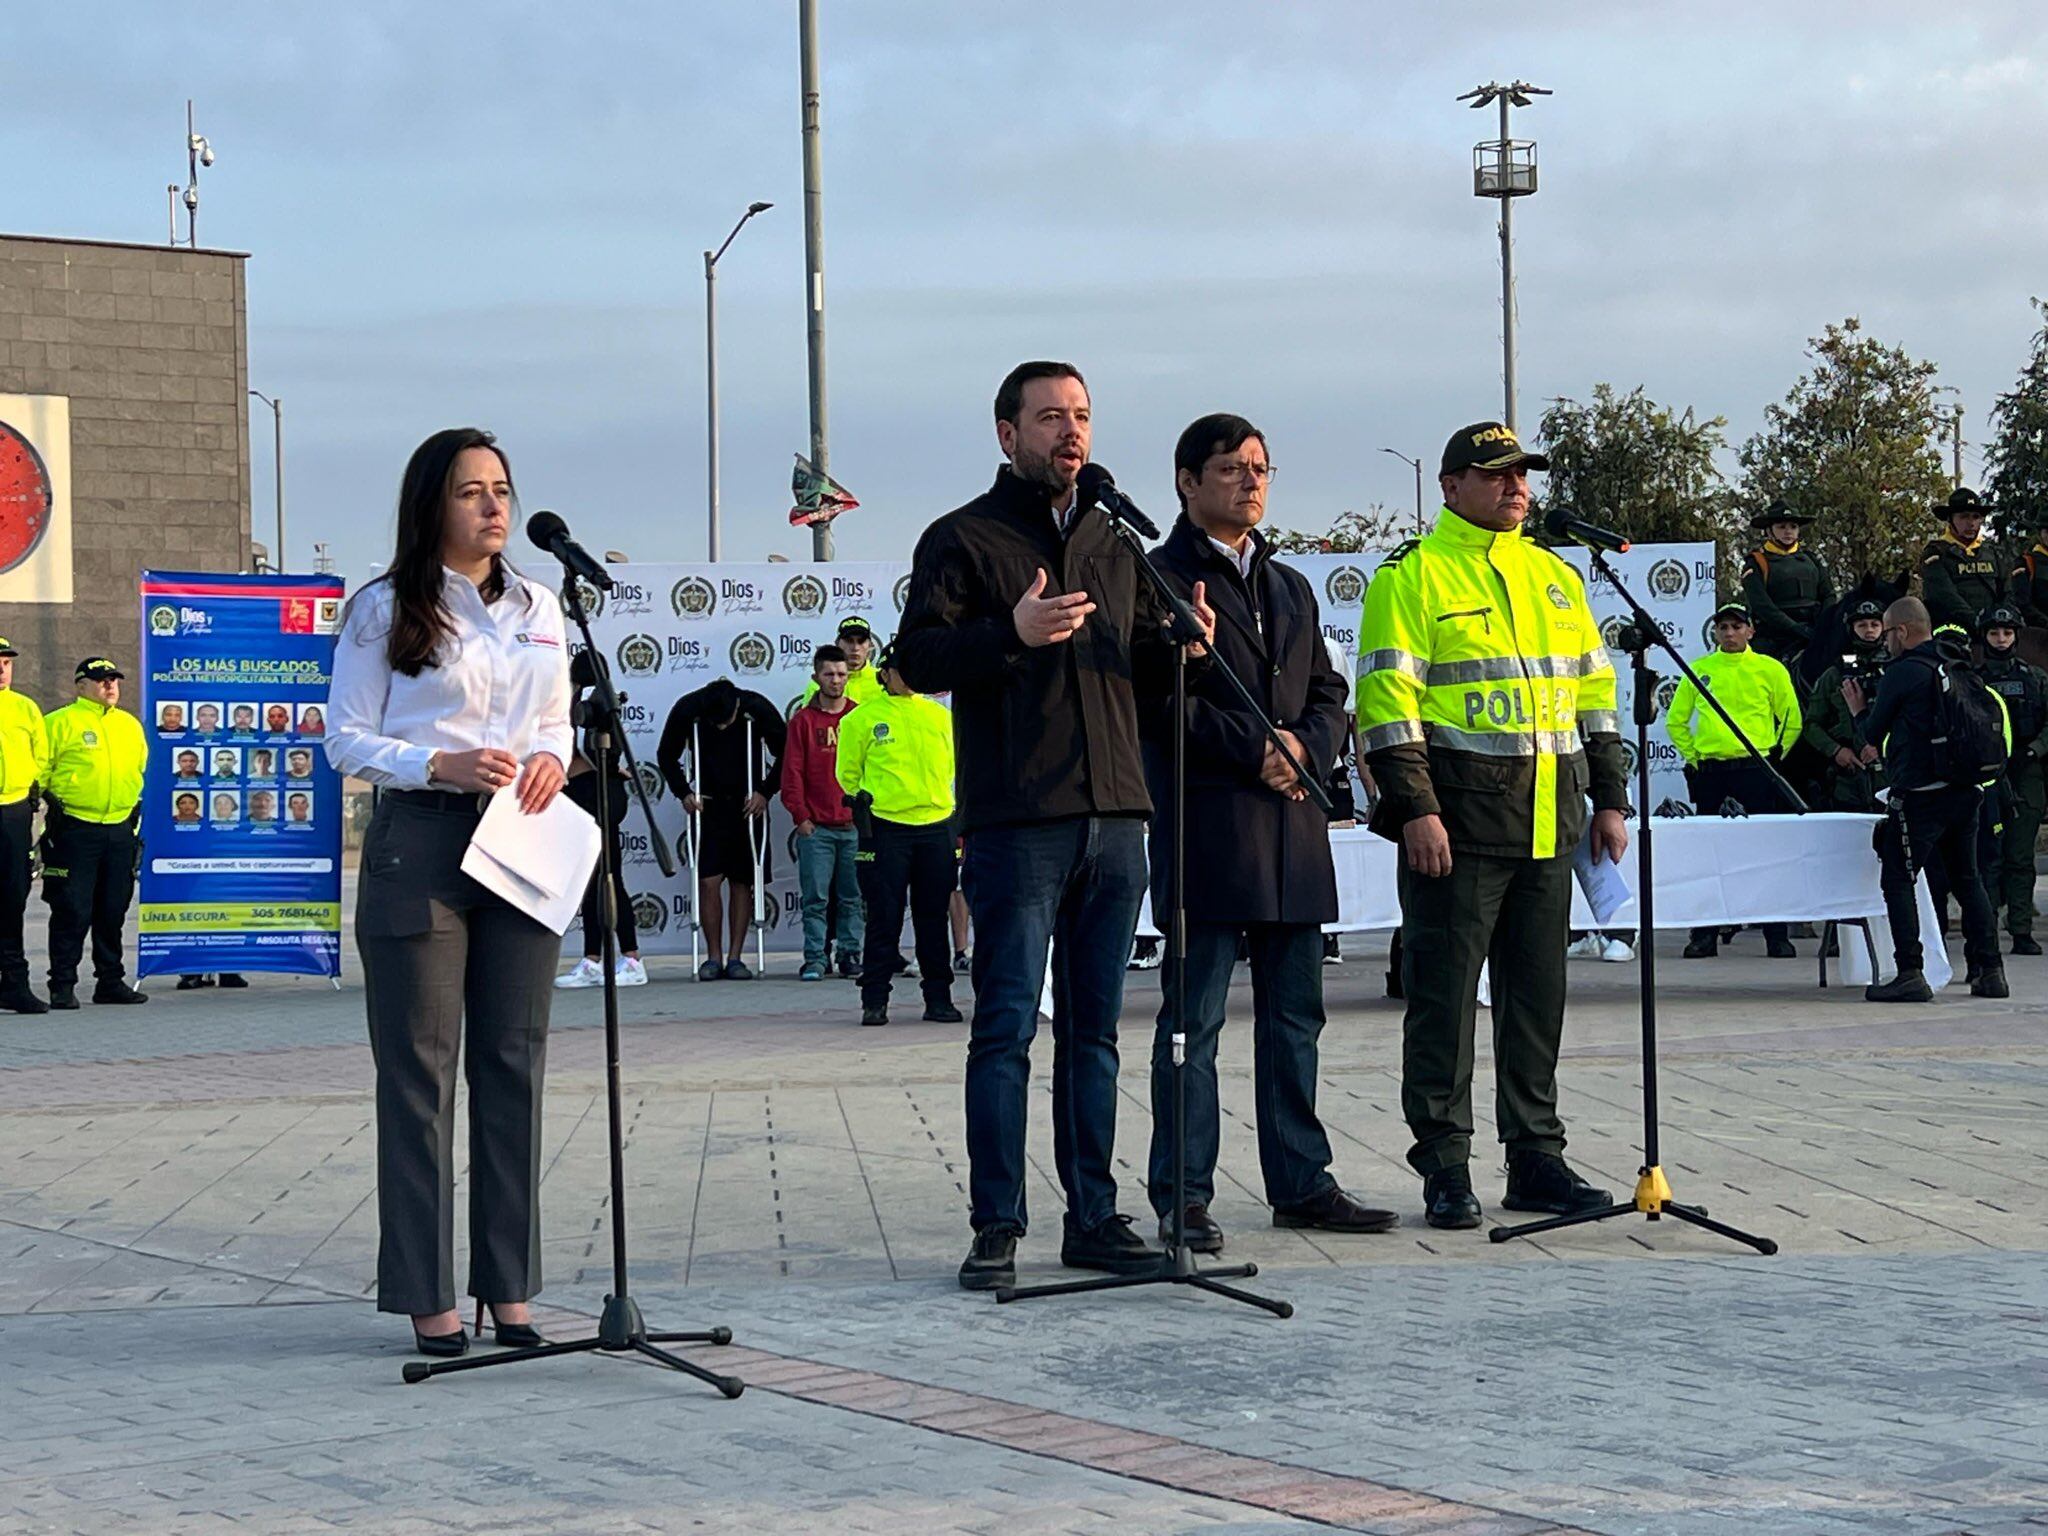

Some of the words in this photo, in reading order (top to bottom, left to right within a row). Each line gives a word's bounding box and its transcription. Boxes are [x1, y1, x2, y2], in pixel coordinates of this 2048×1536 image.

[1623, 573, 1629, 583] y
[611, 581, 642, 600] Dios
[647, 591, 652, 600] y
[722, 579, 754, 598] Dios
[757, 590, 763, 600] y
[832, 577, 864, 597] Dios
[868, 589, 873, 599] y
[611, 600, 653, 618] Patria
[722, 599, 764, 616] Patria
[832, 597, 874, 615] Patria
[566, 638, 588, 659] ios
[668, 636, 700, 656] Dios
[704, 647, 710, 657] y
[780, 634, 811, 654] Dios
[173, 658, 201, 672] LOS
[240, 660, 319, 673] BUSCADOS
[668, 655, 711, 674] Patria
[620, 705, 645, 720] ios
[649, 711, 655, 722] y
[1647, 740, 1677, 759] Dios
[619, 831, 648, 851] Dios
[142, 910, 176, 922] LÍNEA
[180, 912, 230, 922] SEGURA:
[251, 908, 275, 918] 305
[256, 936, 301, 945] ABSOLUTA
